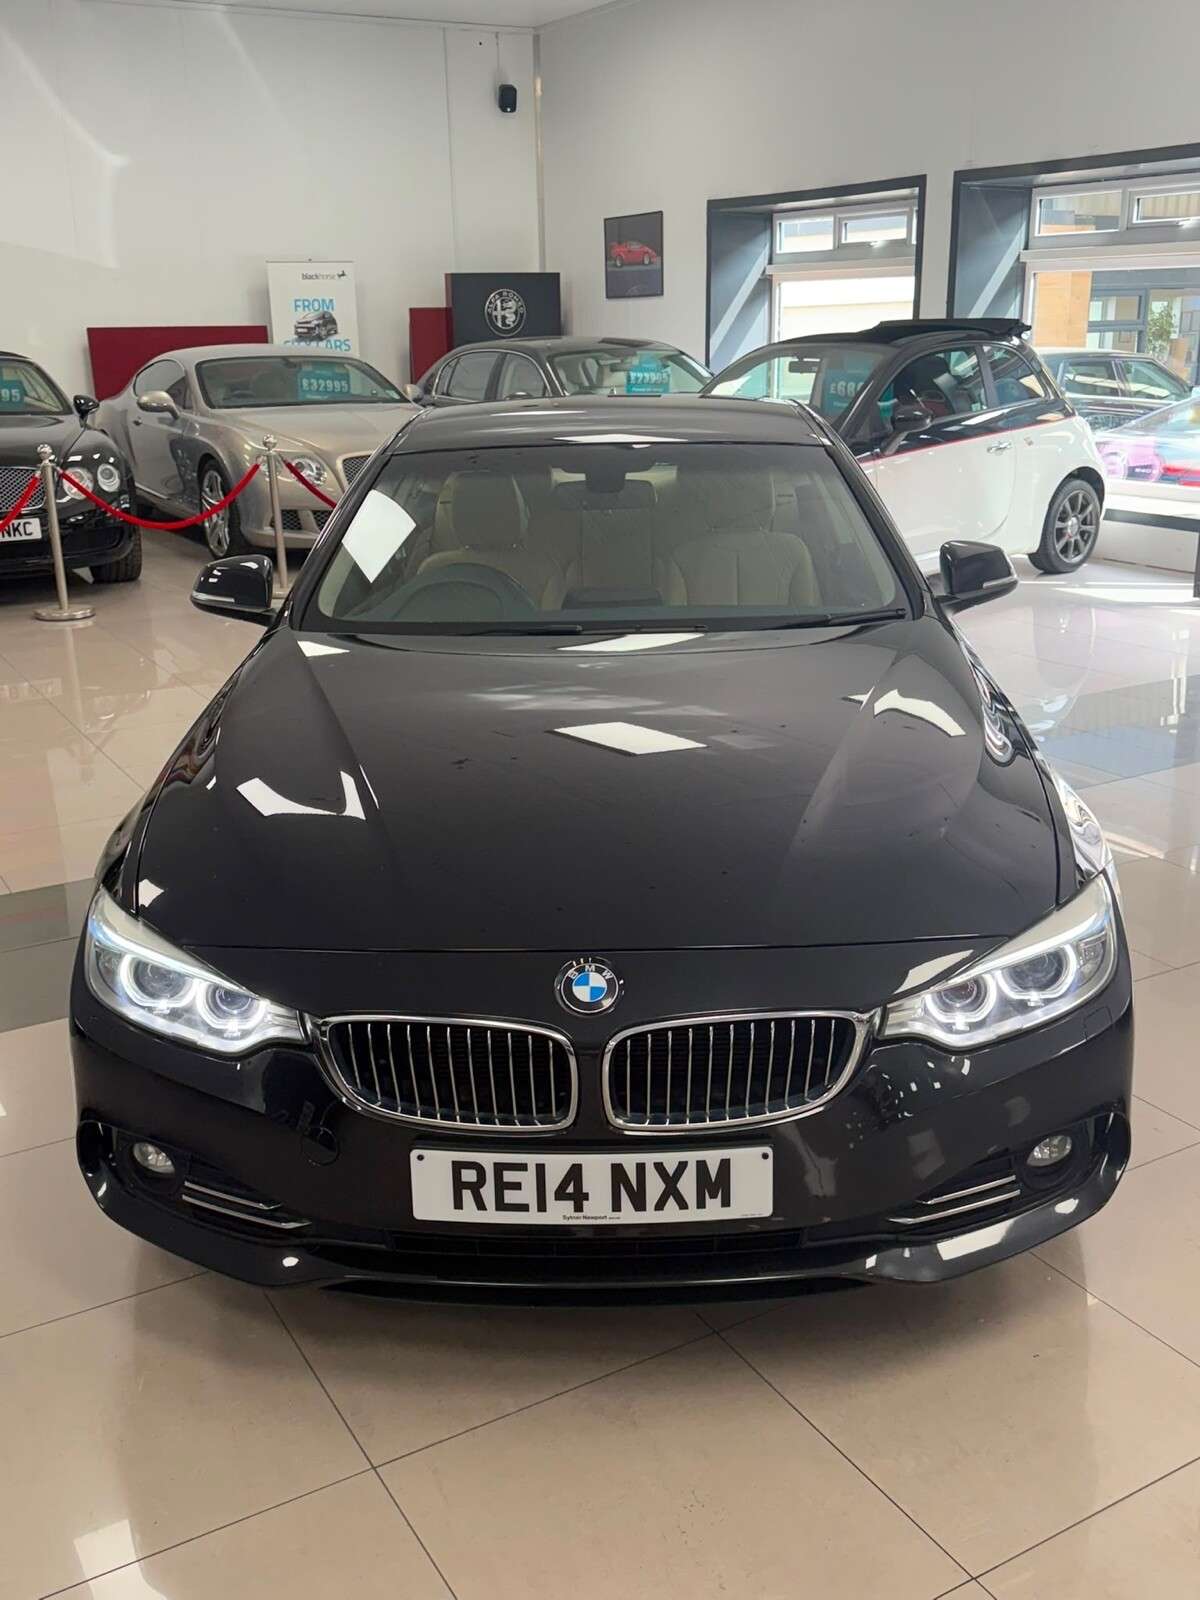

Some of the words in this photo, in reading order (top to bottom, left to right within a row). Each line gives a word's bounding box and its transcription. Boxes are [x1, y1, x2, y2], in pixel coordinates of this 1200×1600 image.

[294, 298, 335, 313] FROM
[302, 378, 349, 393] £32995
[568, 964, 613, 980] BMW
[451, 1160, 590, 1213] RE14
[611, 1158, 731, 1213] NXM
